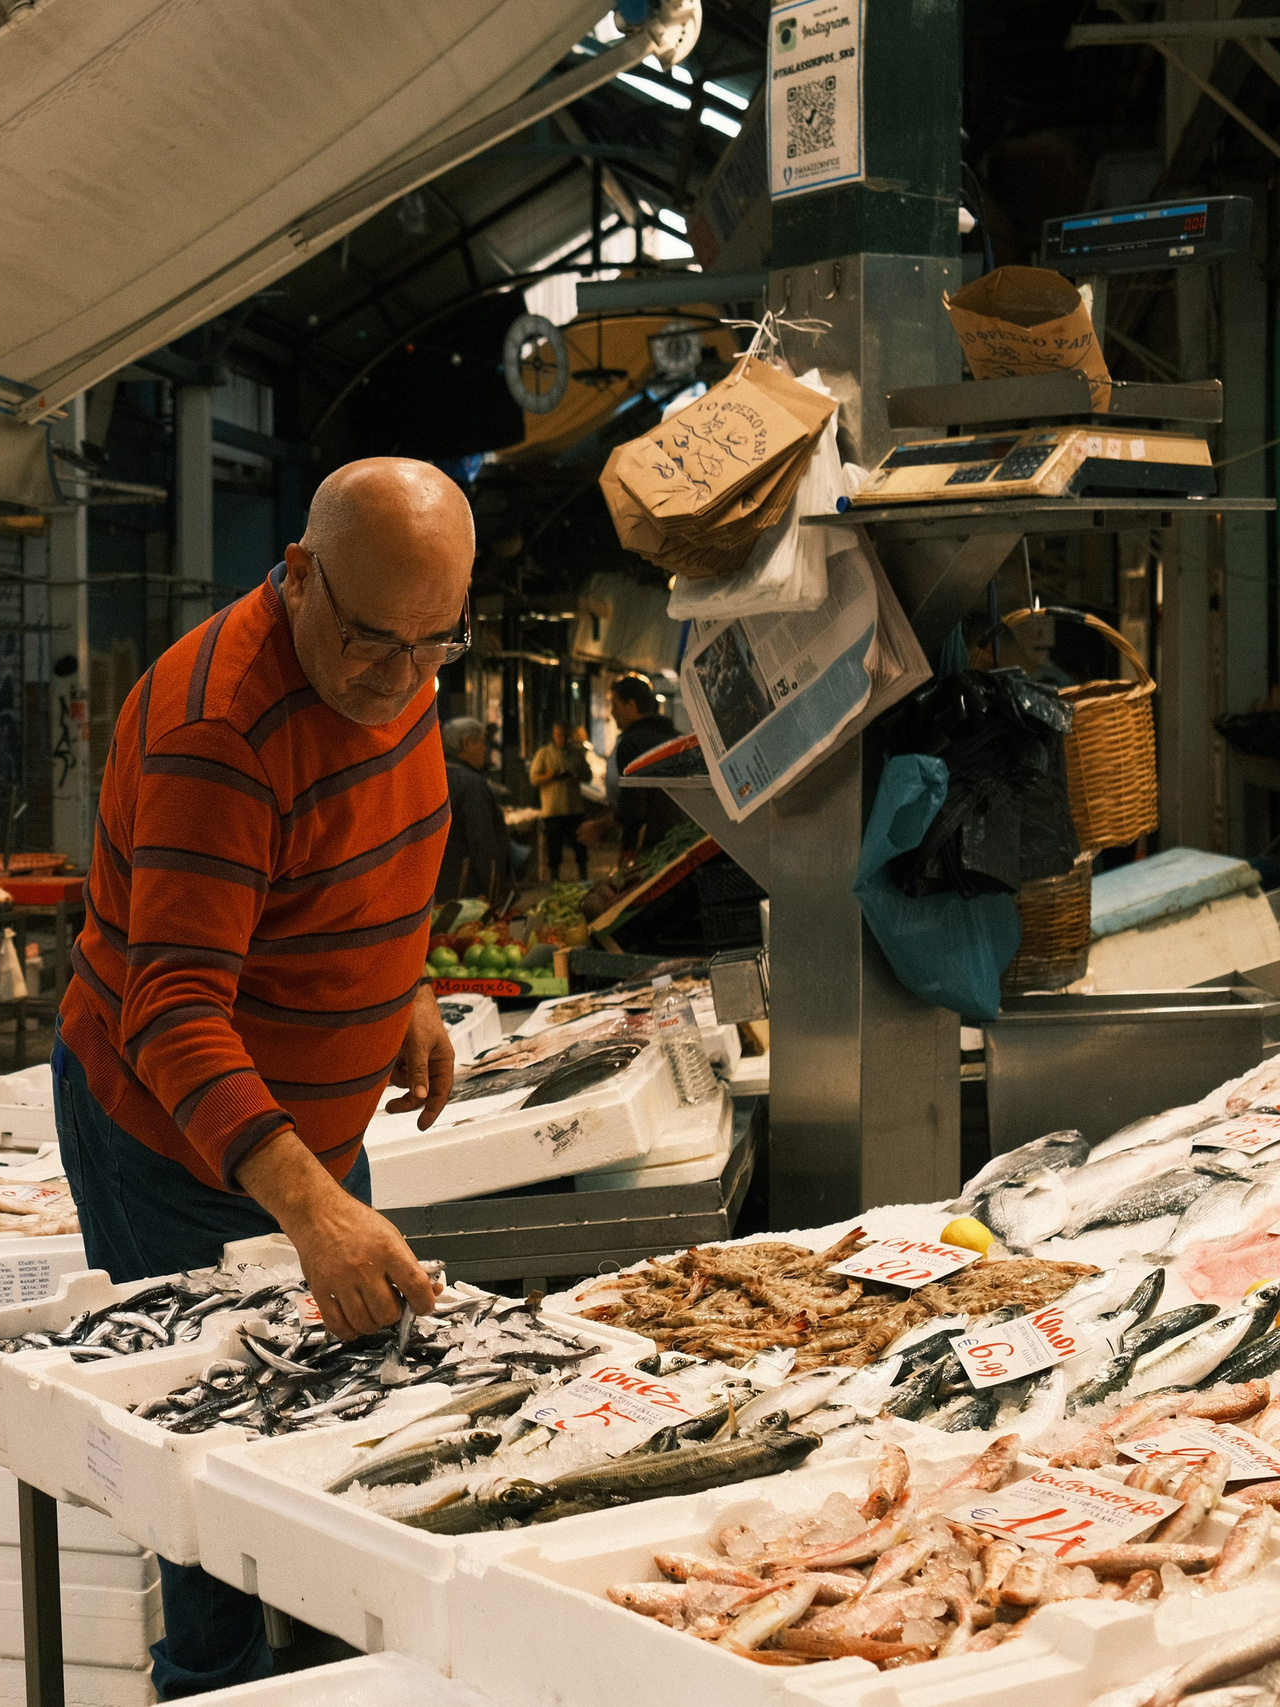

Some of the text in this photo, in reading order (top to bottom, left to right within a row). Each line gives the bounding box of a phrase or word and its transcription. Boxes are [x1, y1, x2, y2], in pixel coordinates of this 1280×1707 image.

[802, 17, 849, 38] Instagram
[721, 402, 764, 429] ΦΡΕΣΚΟ
[751, 430, 767, 462] ΨΑΡΙ
[970, 1507, 1095, 1558] € 14
